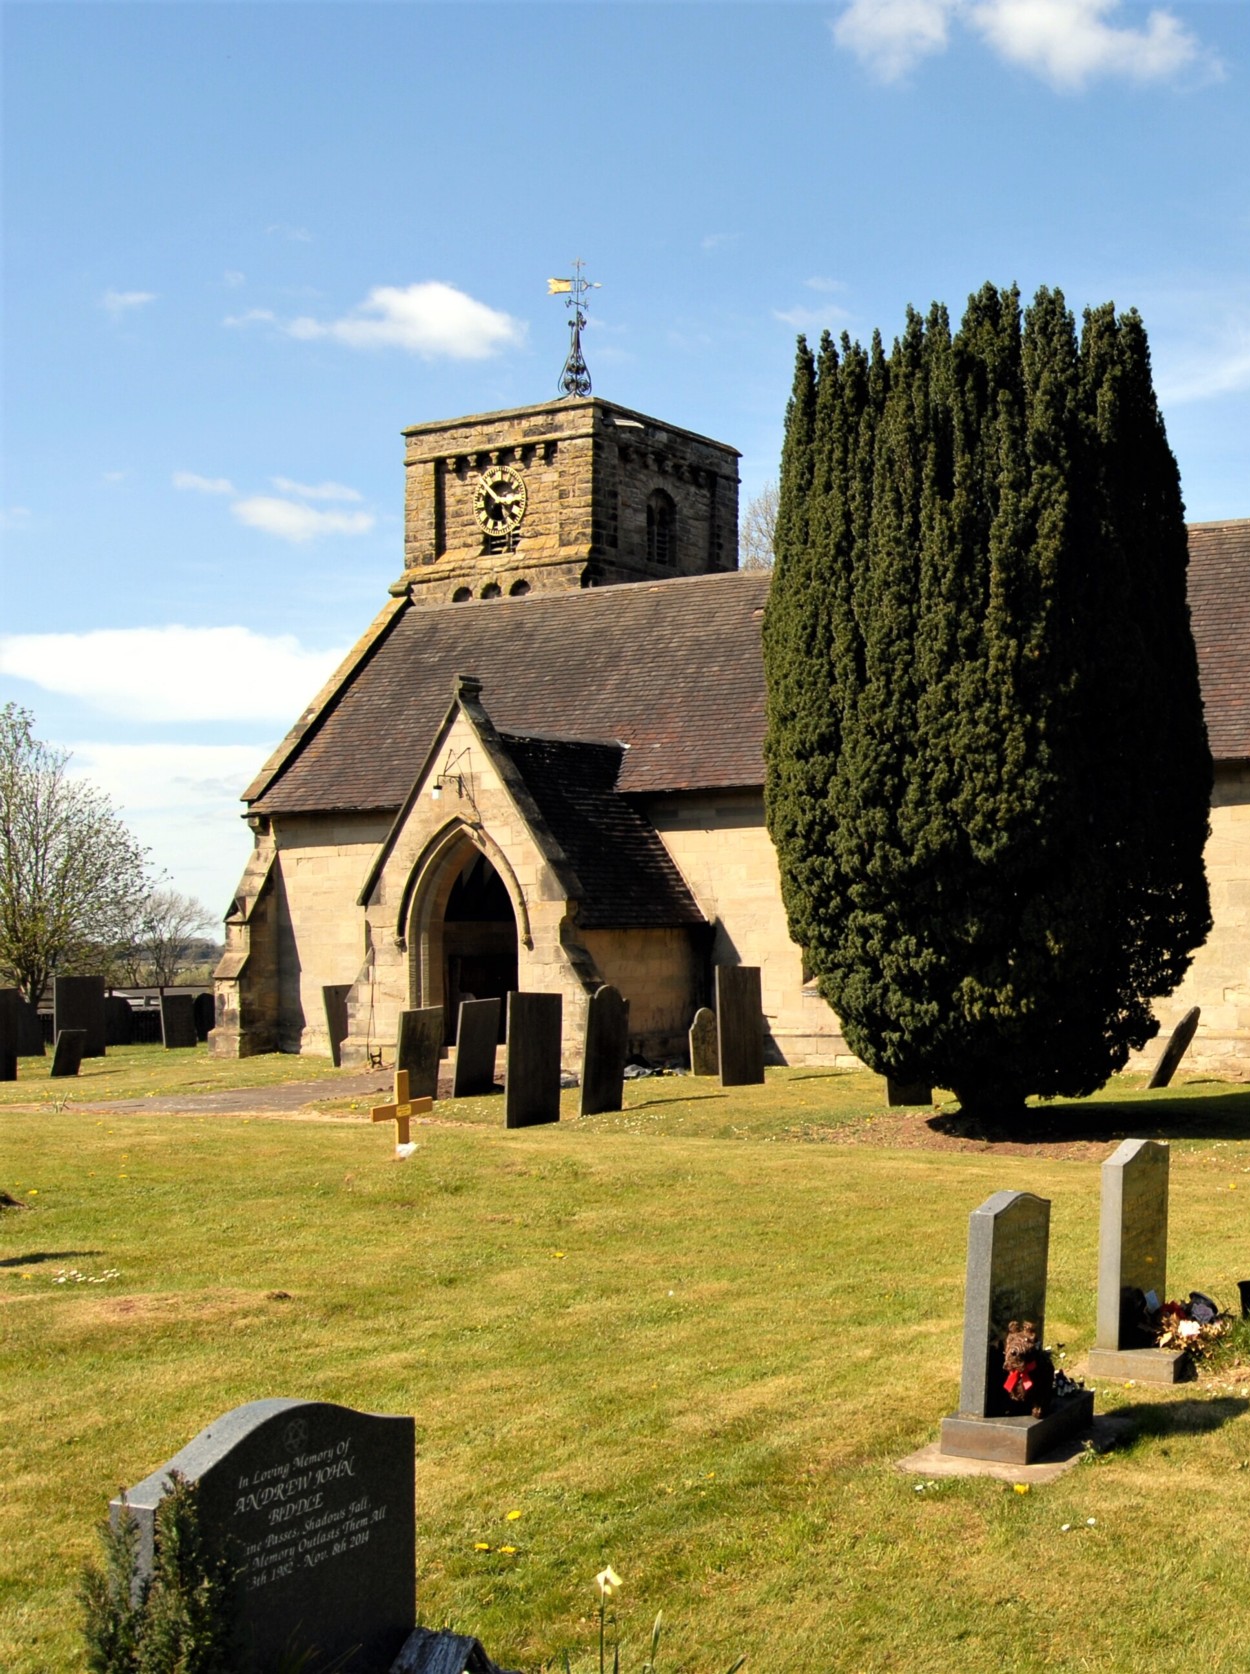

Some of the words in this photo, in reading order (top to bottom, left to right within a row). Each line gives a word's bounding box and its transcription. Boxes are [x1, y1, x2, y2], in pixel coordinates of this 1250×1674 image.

[238, 1475, 249, 1489] In
[253, 1463, 290, 1485] Loving
[292, 1448, 334, 1471] Memory
[336, 1436, 351, 1457] Of
[233, 1471, 312, 1516] ANDREW
[313, 1455, 355, 1488] JOHN
[268, 1492, 324, 1526] BIDDLE
[301, 1509, 346, 1535] Shadows
[252, 1546, 296, 1571] Memory
[298, 1528, 340, 1552] Outlasts
[342, 1516, 369, 1535] Them
[370, 1504, 388, 1524] All
[331, 1537, 347, 1556] 8th
[349, 1529, 370, 1549] 2014
